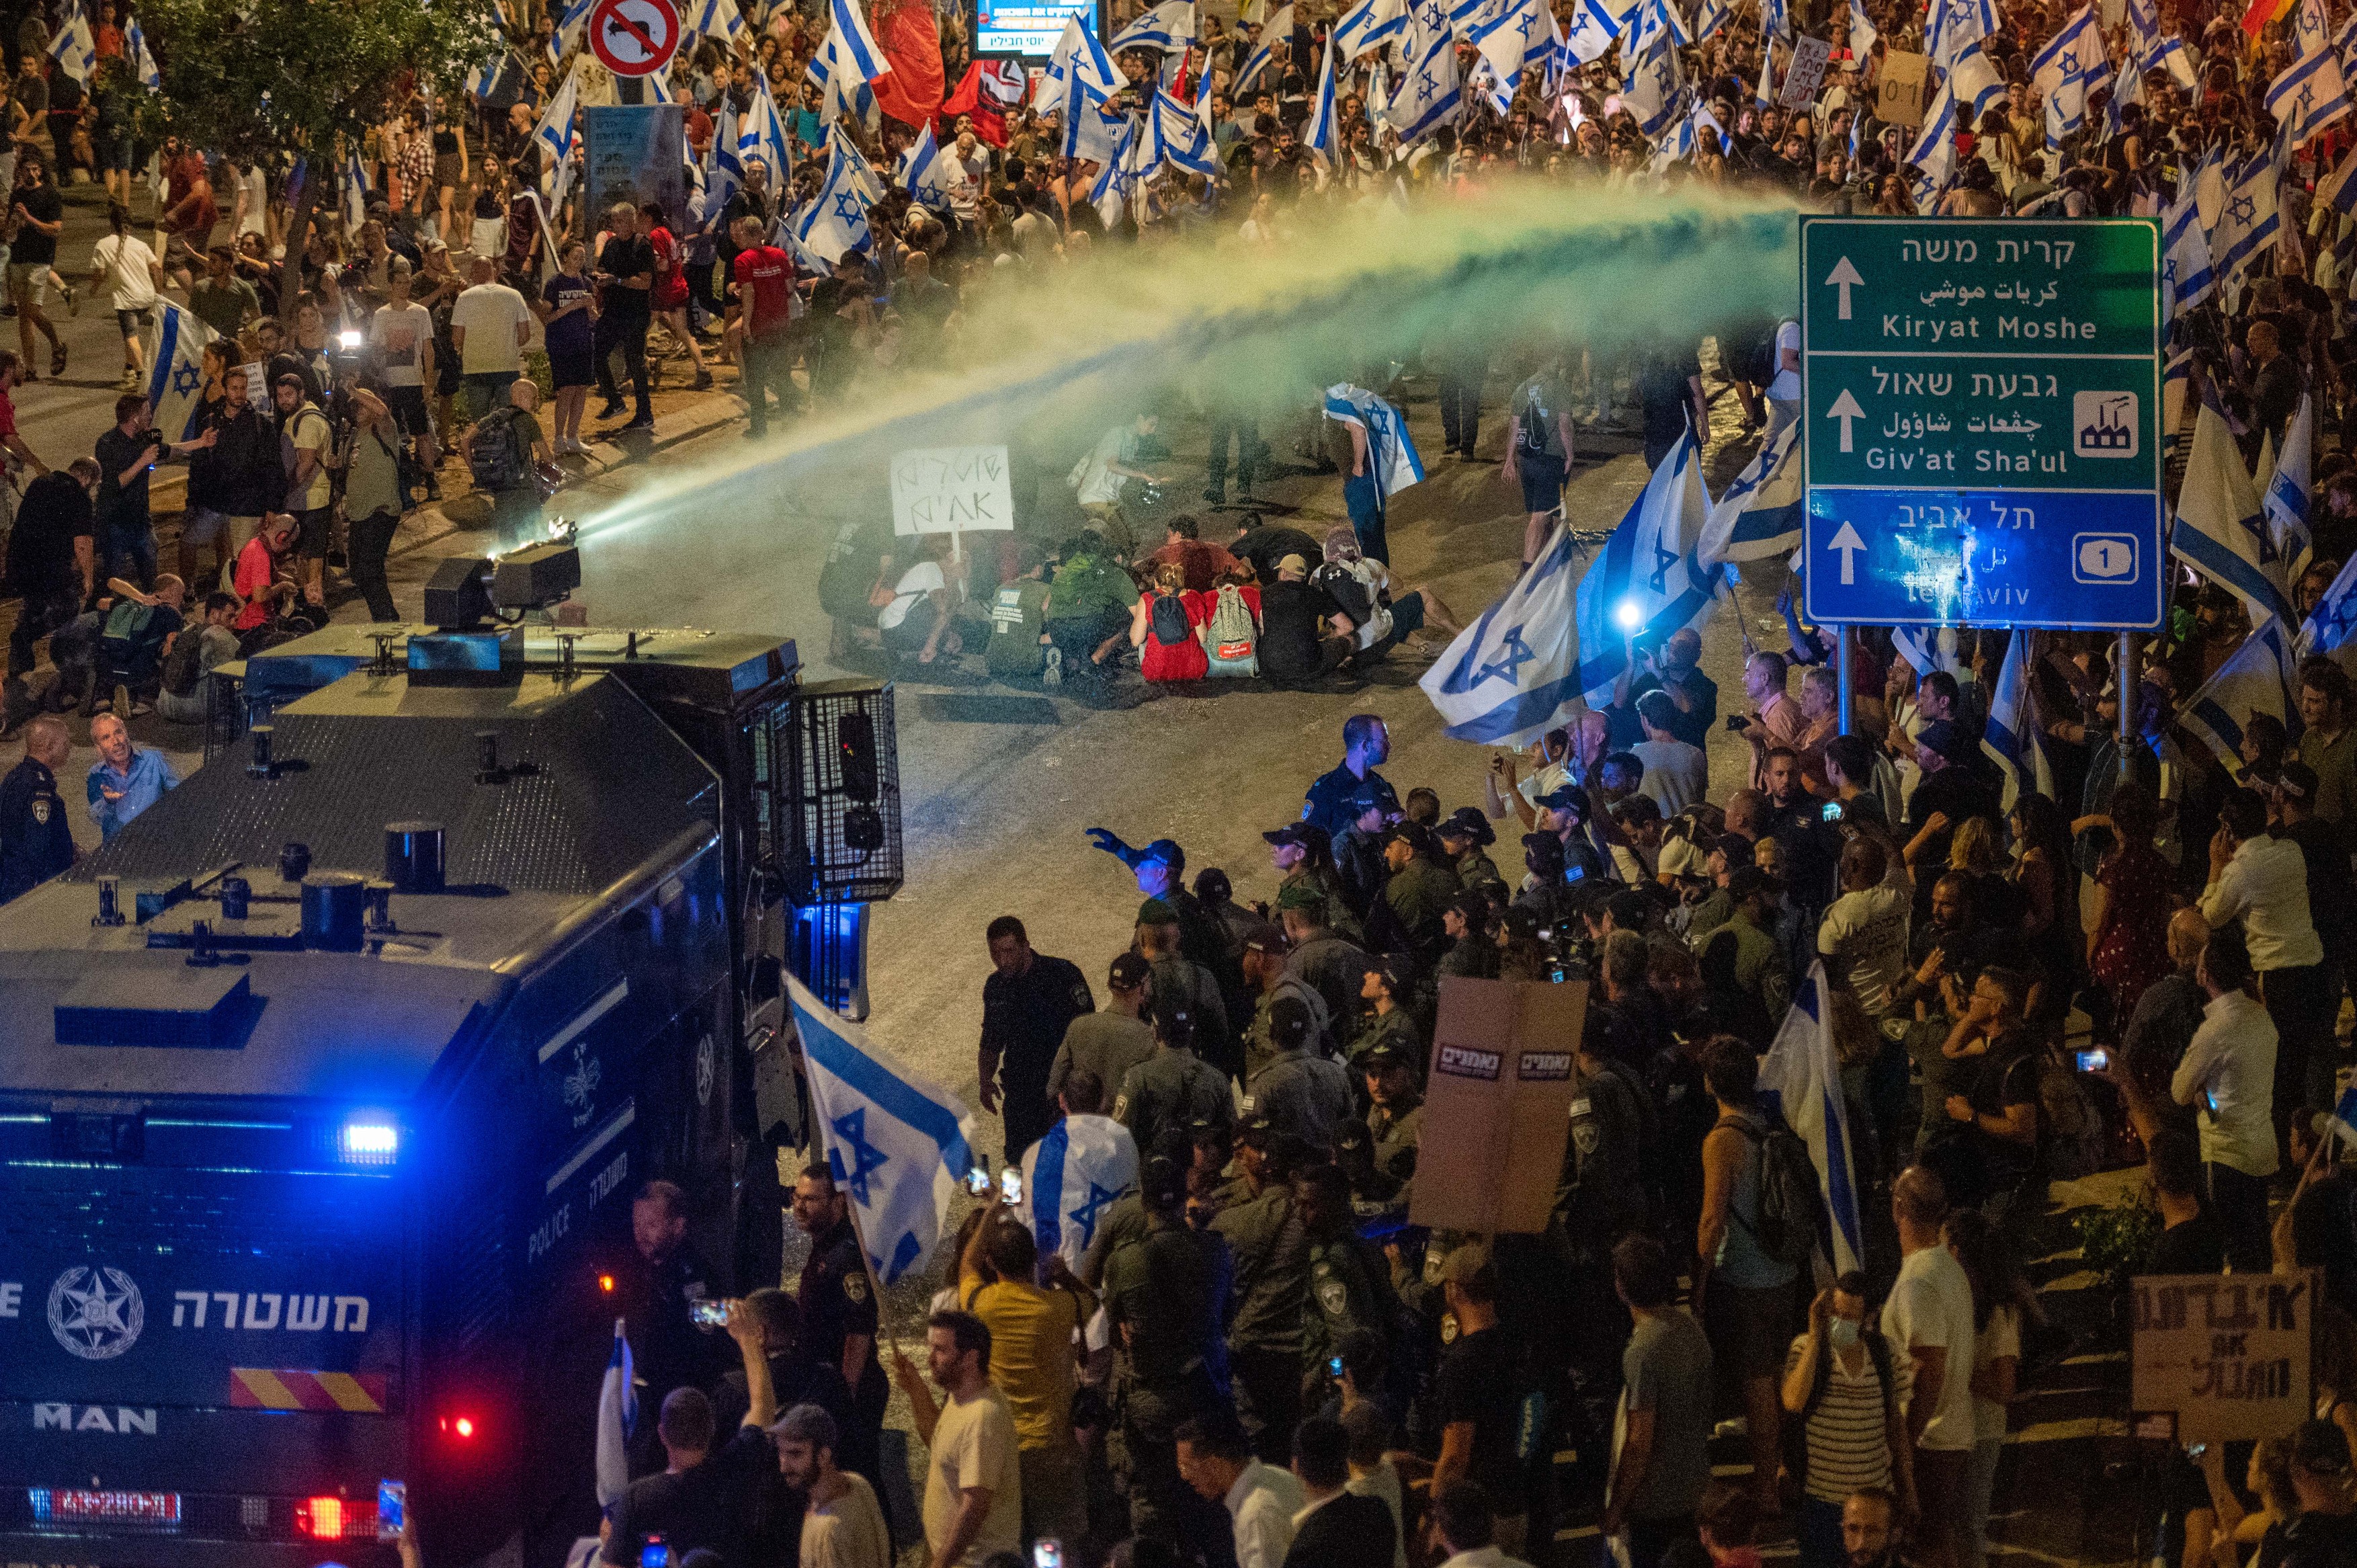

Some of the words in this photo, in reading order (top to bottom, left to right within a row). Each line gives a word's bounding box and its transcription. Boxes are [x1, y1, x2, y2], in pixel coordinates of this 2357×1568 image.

[1026, 37, 1044, 46] יוסי
[1903, 239, 1977, 263] משה
[1996, 239, 2075, 270] קרית
[1920, 280, 1986, 306] موشي
[1994, 280, 2058, 308] كريات
[1883, 315, 1979, 343] Kiryat
[1998, 316, 2096, 339] Moshe
[1871, 366, 1952, 396] שאול
[1971, 374, 2058, 400] גבעת
[1883, 411, 1951, 439] شاؤول
[1866, 447, 1955, 470] Giv'at
[1975, 449, 2067, 472] Sha'ul
[1899, 505, 1971, 528] אביב
[1990, 500, 2035, 530] תל
[2099, 546, 2110, 570] 1
[528, 1203, 571, 1264] POLICE
[172, 1290, 370, 1333] משטרה
[33, 1403, 157, 1435] MAN
